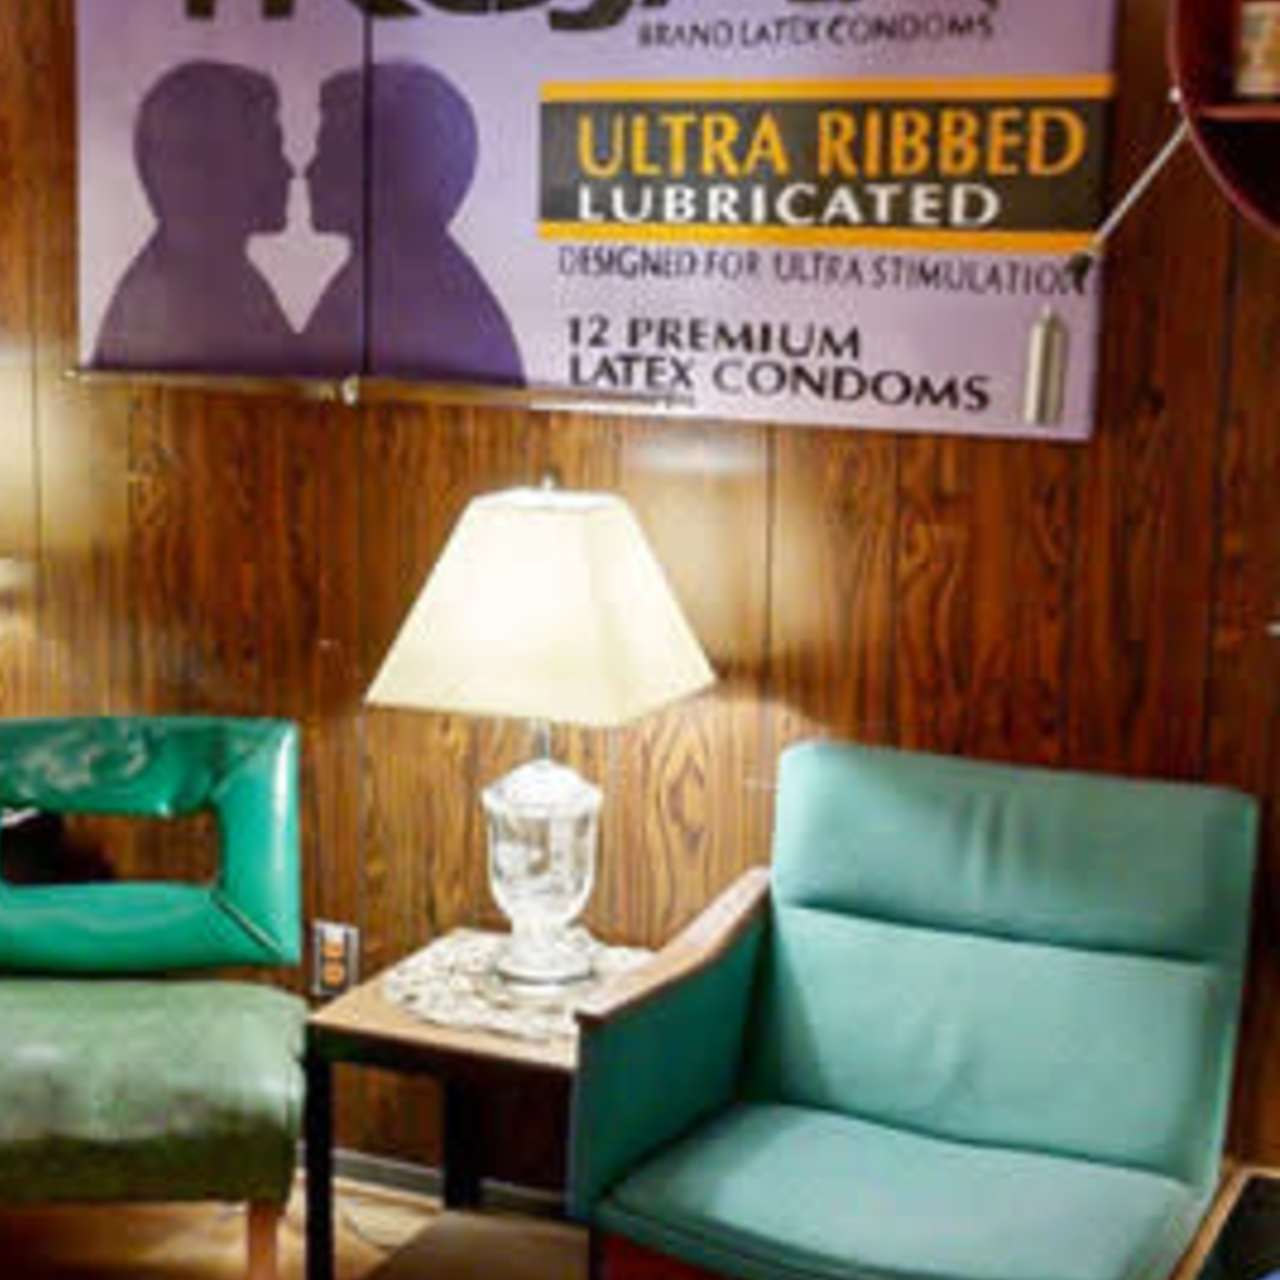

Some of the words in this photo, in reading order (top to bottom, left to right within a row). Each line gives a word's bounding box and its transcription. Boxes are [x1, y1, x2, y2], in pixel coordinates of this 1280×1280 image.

[638, 18, 732, 50] BRAND
[740, 16, 822, 48] LATEX
[826, 12, 996, 44] CONDOMS
[576, 110, 790, 178] ULTRA
[816, 106, 1090, 176] RIBBED
[578, 180, 1002, 228] LUBRICATED
[558, 246, 696, 278] DESIGNED
[704, 250, 758, 278] FOR
[774, 254, 866, 286] ULTRA
[568, 316, 610, 348] 12
[626, 318, 862, 360] PREMIUM
[570, 354, 692, 390] LATEX
[712, 360, 992, 414] CONDOMS
